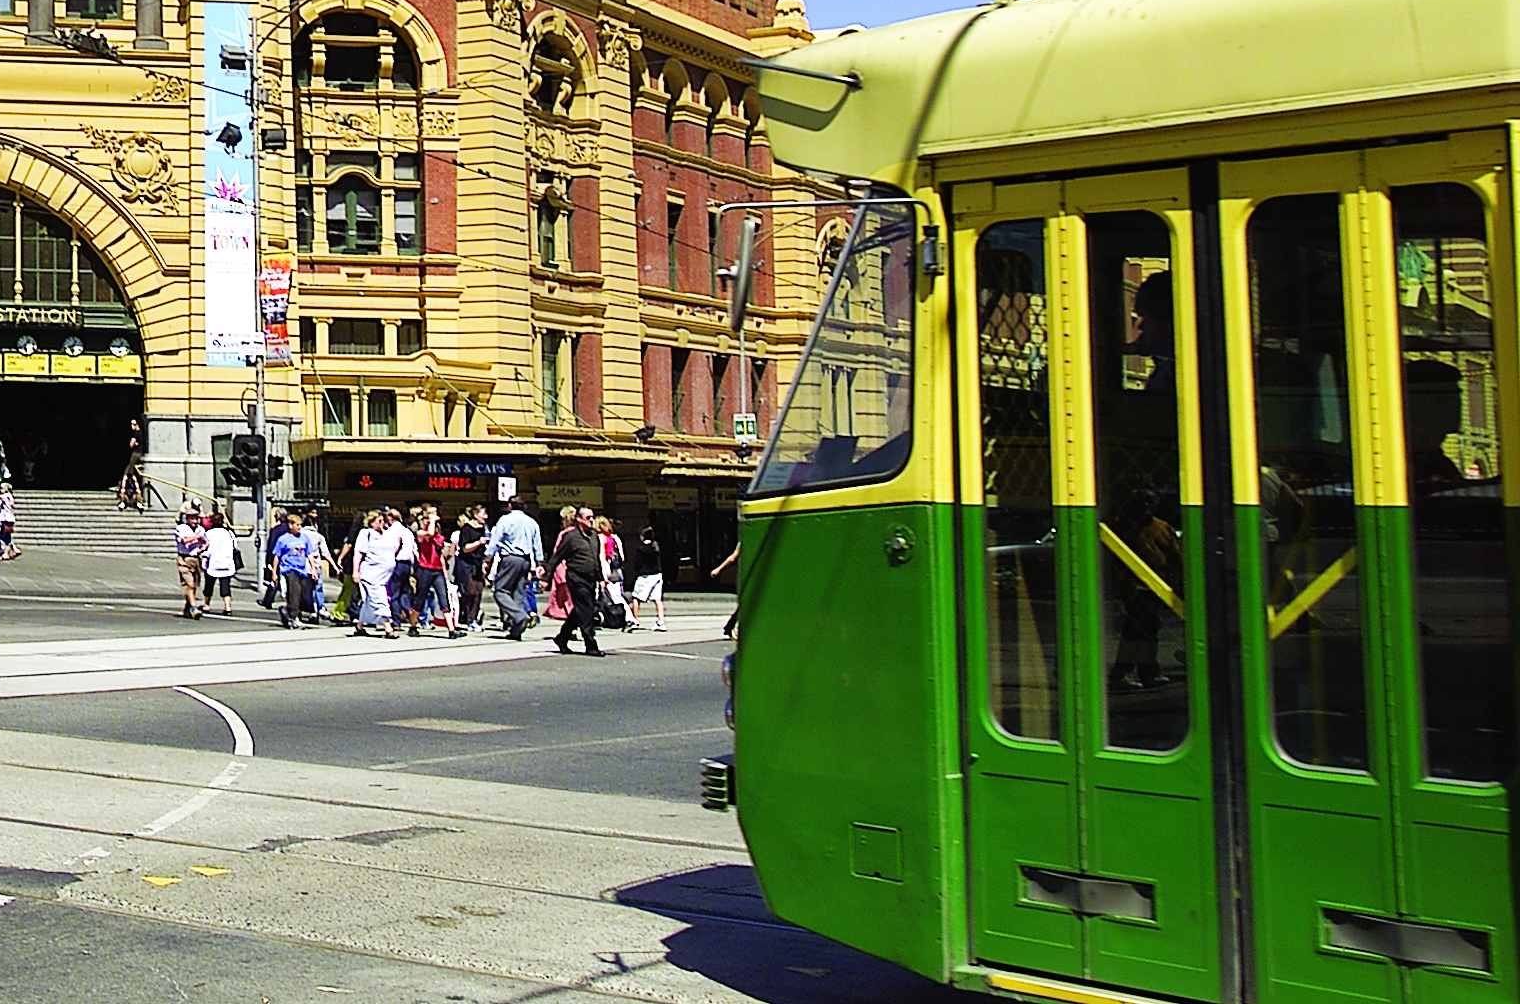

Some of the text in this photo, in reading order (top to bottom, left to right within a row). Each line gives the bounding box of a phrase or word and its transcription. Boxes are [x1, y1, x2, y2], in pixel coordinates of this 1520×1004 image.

[209, 234, 249, 250] TOWN
[428, 463, 506, 474] HATS & CAPS
